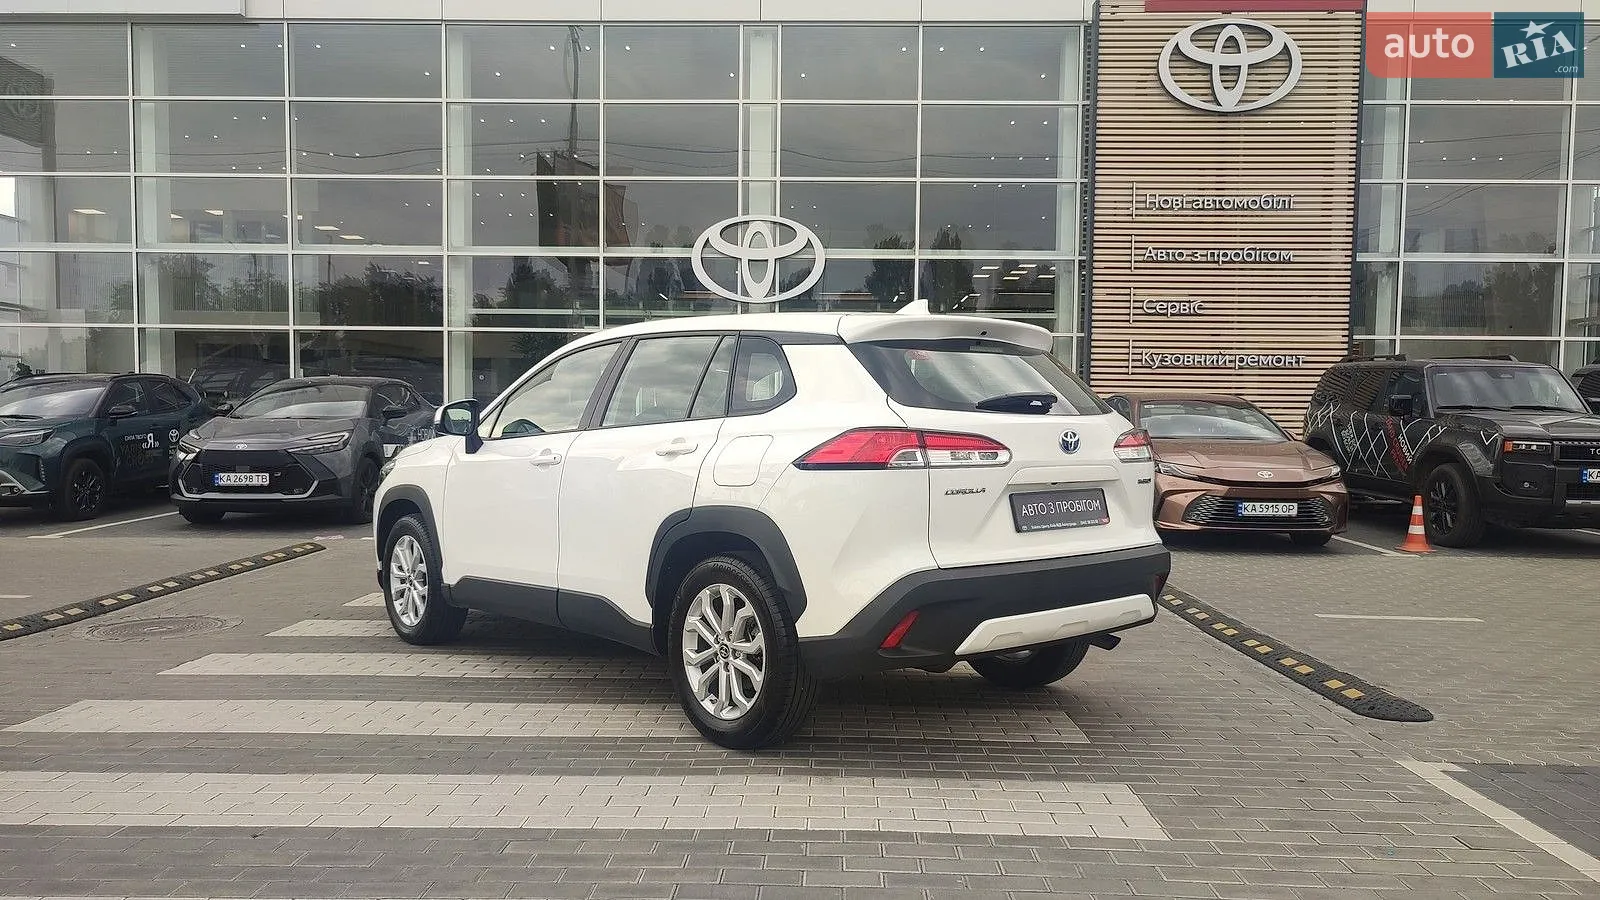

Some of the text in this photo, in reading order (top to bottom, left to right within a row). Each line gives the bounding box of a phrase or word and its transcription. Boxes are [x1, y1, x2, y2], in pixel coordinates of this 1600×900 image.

[1144, 193, 1294, 211] Нові автомобілі
[1144, 246, 1294, 266] Авто з пробігом
[1142, 299, 1206, 318] Сервіс
[1142, 349, 1306, 370] Кузовний ремонт
[233, 474, 254, 483] 2698
[1022, 503, 1047, 517] АВТО
[1056, 499, 1101, 513] ПРОБІГОМ
[1259, 504, 1280, 514] 5915
